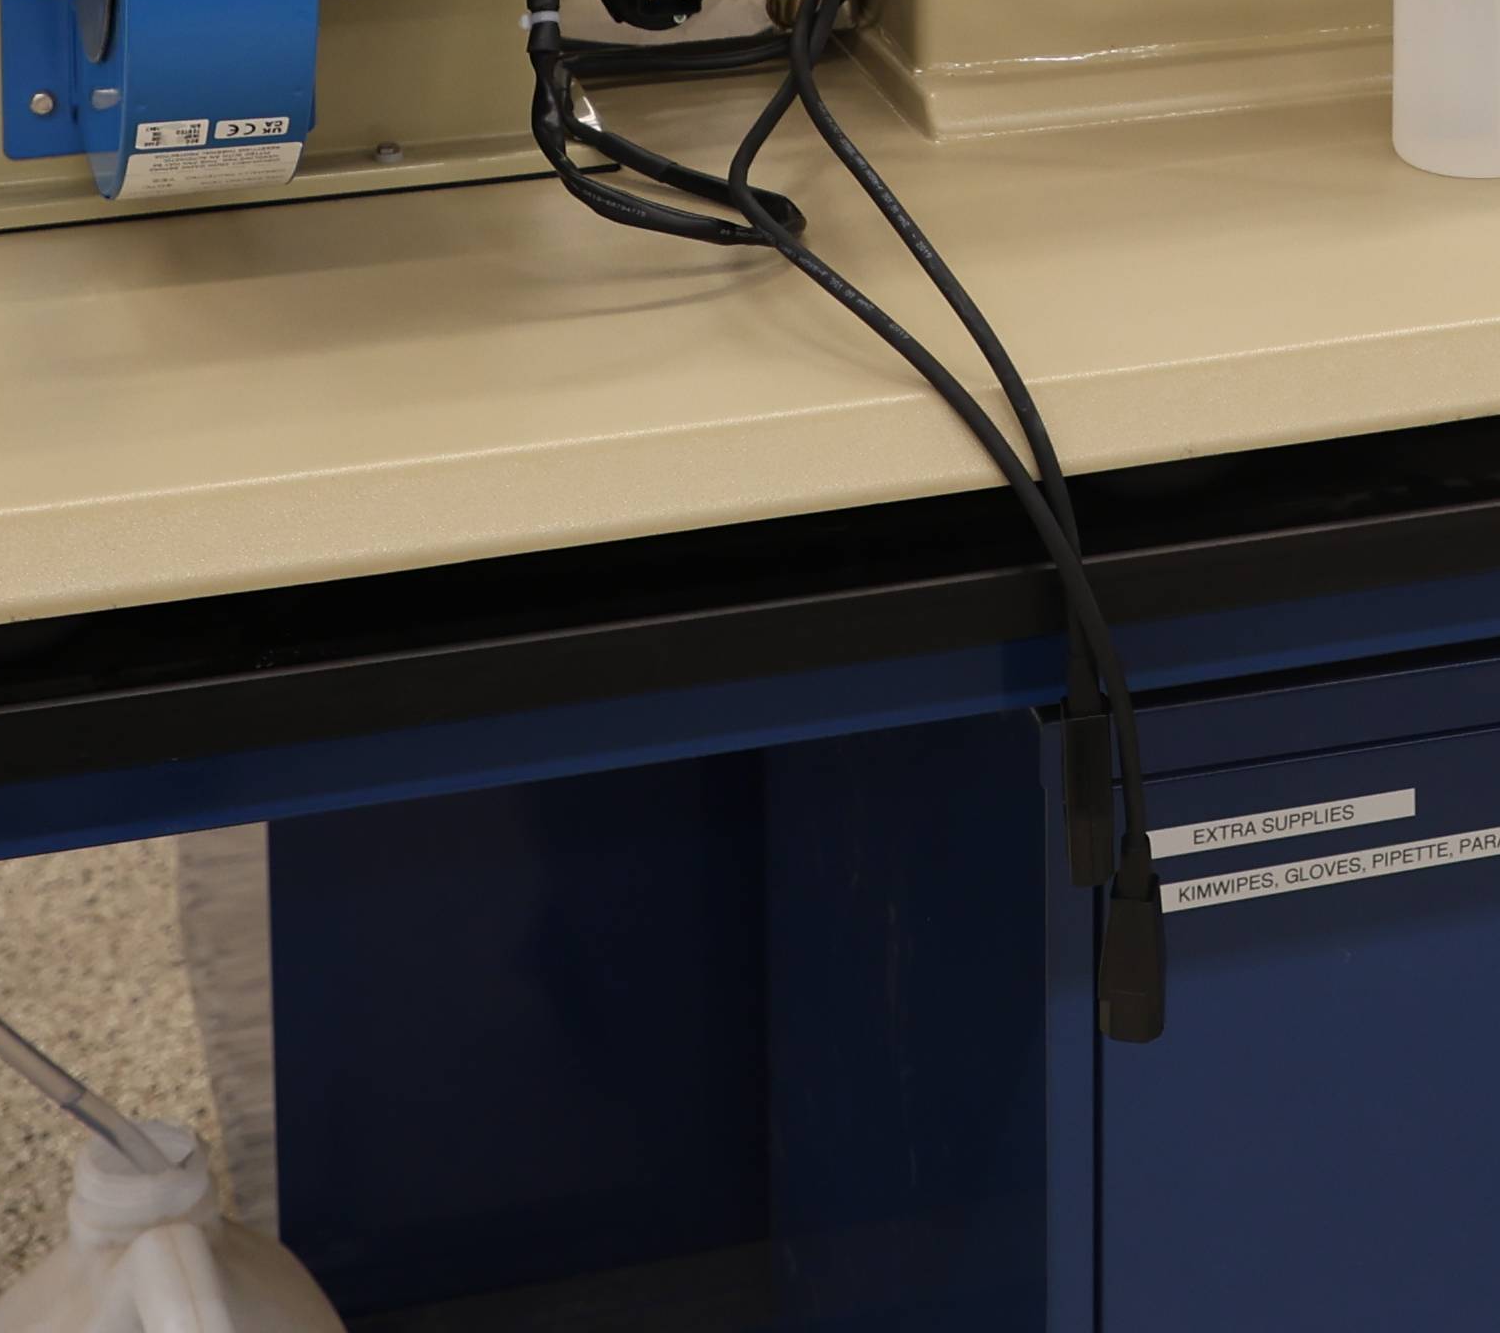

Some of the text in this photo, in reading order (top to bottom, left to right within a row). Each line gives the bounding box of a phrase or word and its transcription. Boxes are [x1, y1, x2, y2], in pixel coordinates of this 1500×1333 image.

[1192, 803, 1355, 845] EXTRA SUPPLIES
[1177, 870, 1280, 903] KIMWIPES,
[1283, 855, 1367, 885] GLOVES,
[1371, 840, 1454, 871] PIPETTE,
